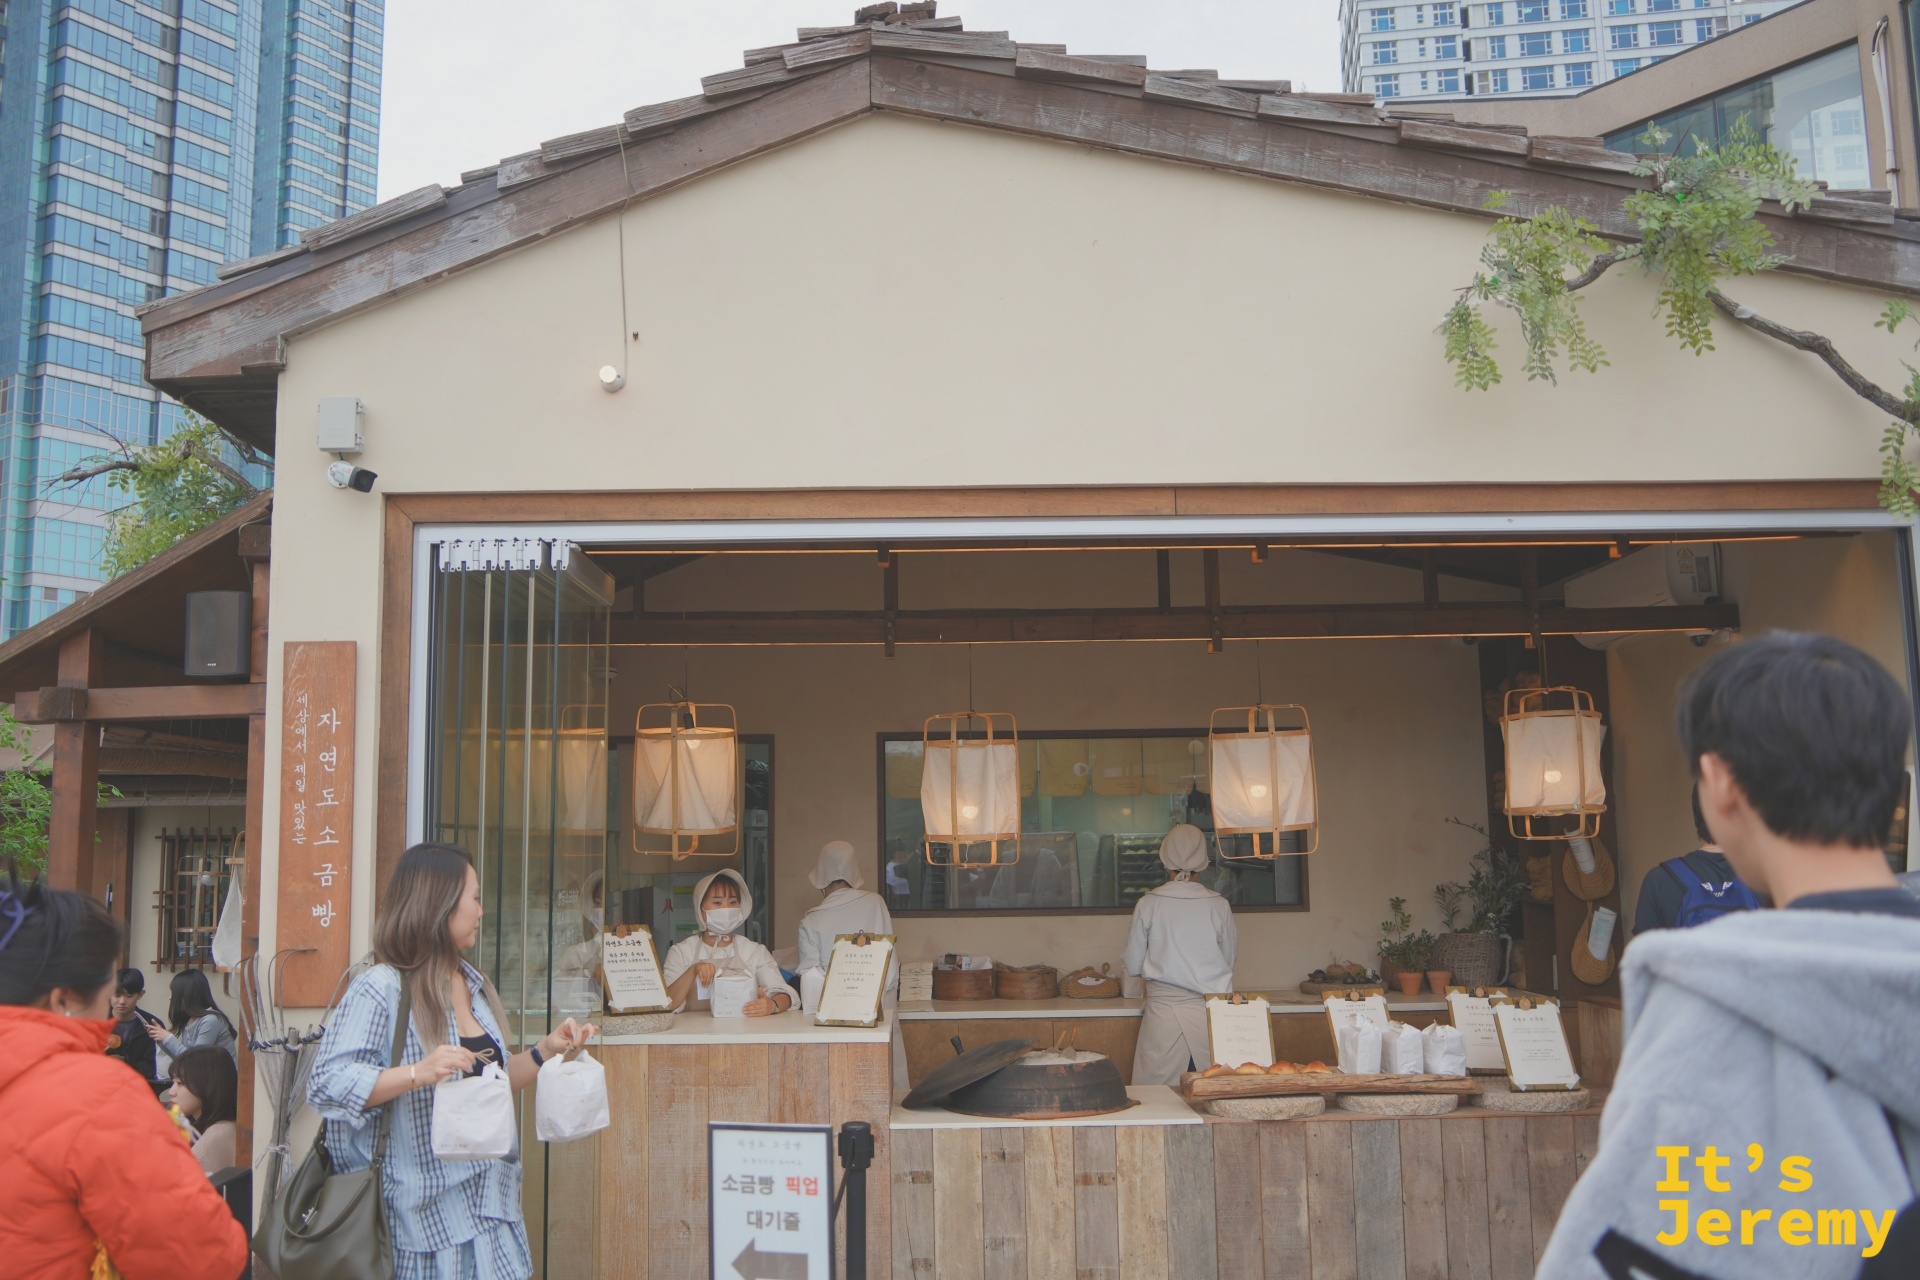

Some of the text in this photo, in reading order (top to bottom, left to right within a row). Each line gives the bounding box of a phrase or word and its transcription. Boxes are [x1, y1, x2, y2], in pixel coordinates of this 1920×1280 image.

[292, 692, 309, 845] 세상에서 제일 맛있는
[312, 707, 341, 928] 자연도소금빵
[721, 1174, 818, 1196] 소금빵 픽업
[746, 1210, 801, 1232] 대기줄
